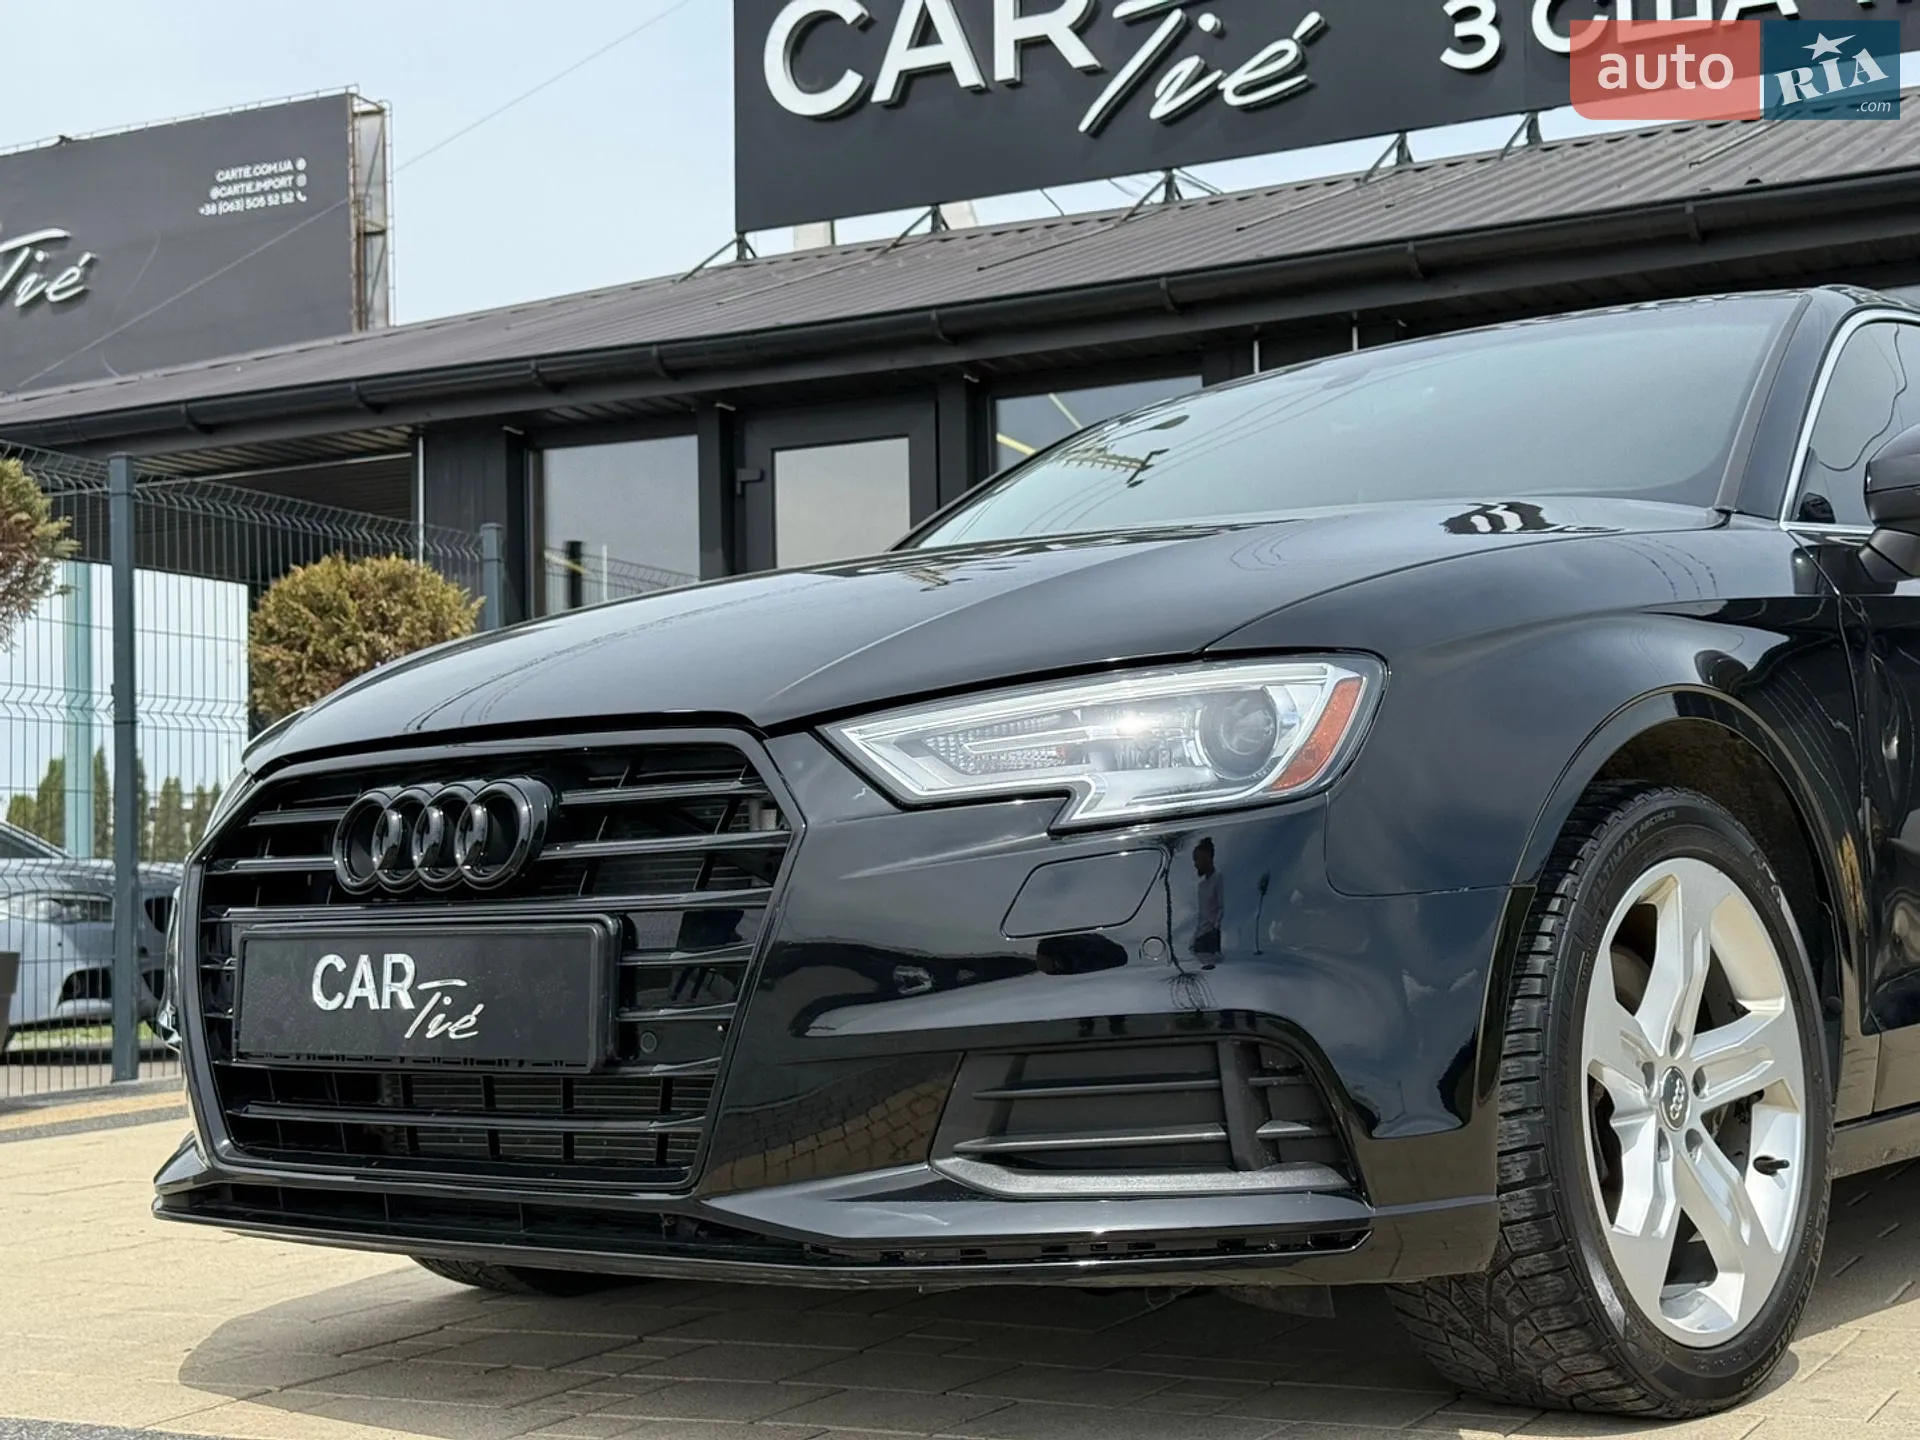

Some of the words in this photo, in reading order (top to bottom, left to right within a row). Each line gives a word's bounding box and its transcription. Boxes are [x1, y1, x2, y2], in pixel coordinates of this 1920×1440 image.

[764, 0, 1100, 117] CAR
[311, 953, 416, 1011] CAR
[404, 978, 485, 1040] Tié
